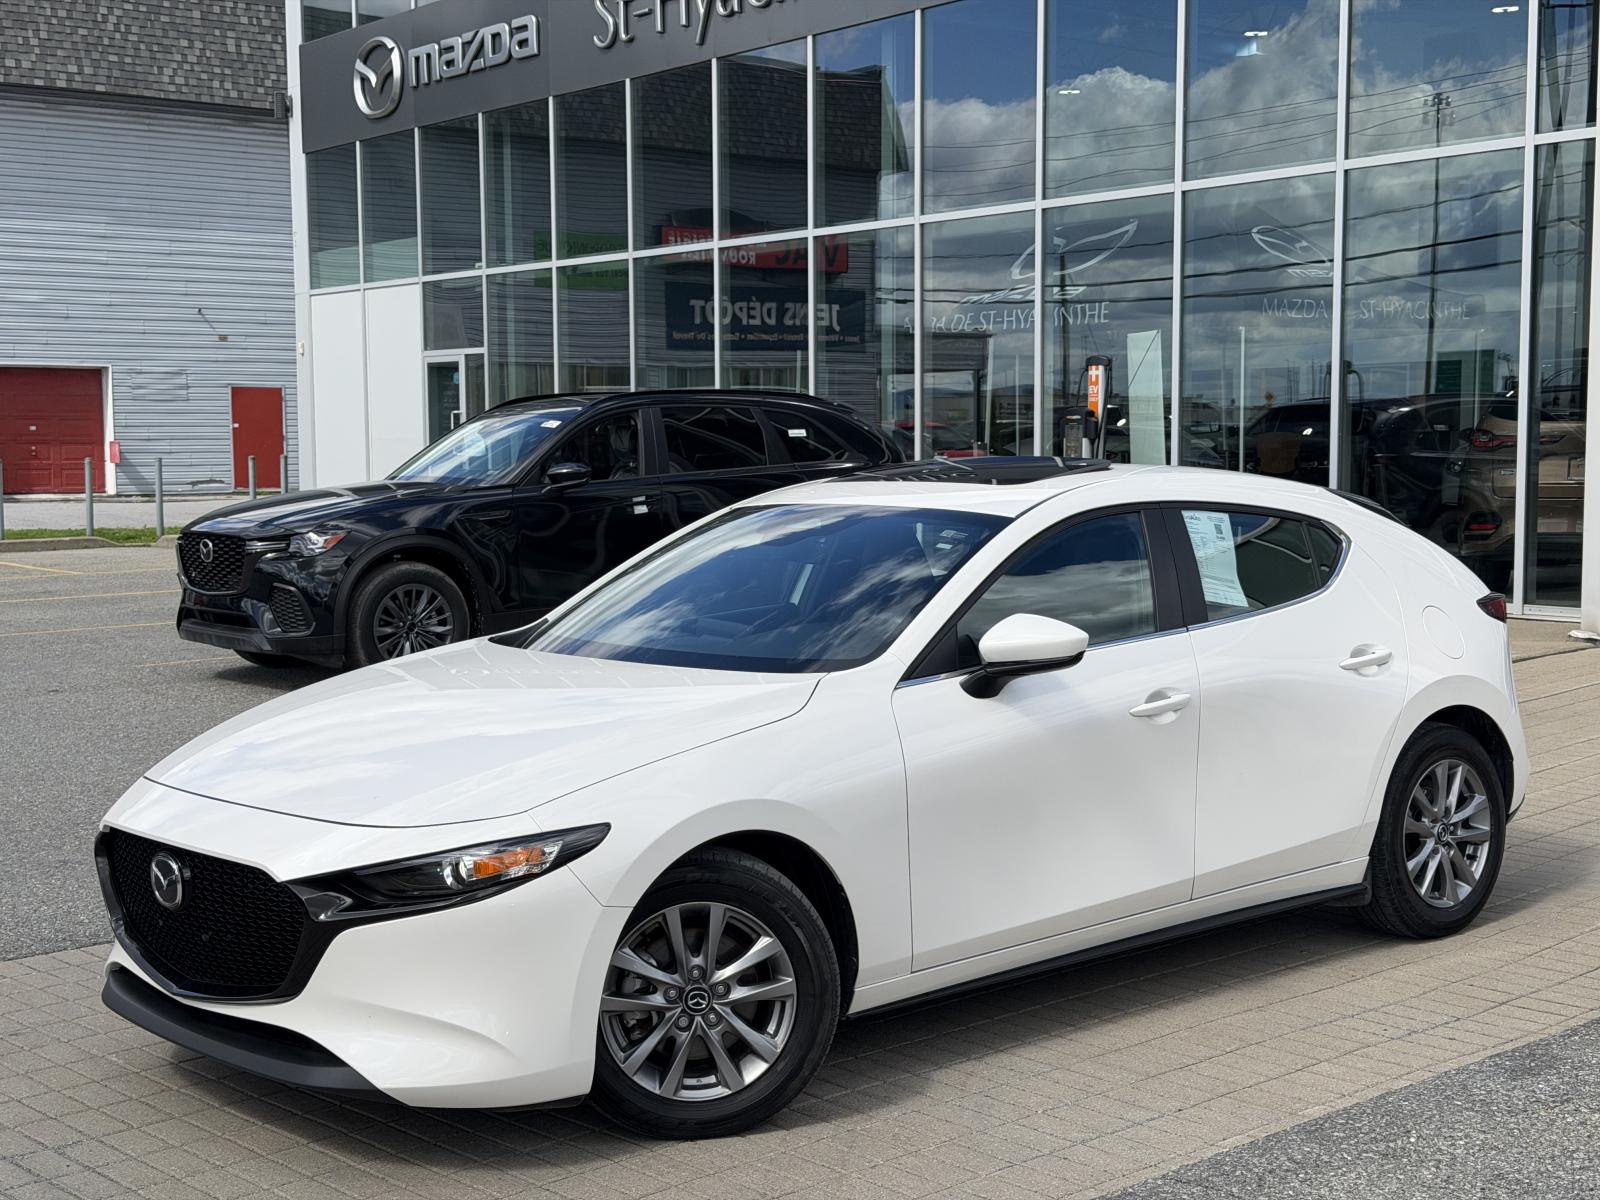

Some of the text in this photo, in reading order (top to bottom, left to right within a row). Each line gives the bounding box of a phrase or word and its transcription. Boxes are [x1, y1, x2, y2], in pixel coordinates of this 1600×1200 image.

[408, 14, 540, 88] mazda
[979, 302, 1109, 331] ST-HYAINTHE
[1262, 298, 1328, 319] MAZDA
